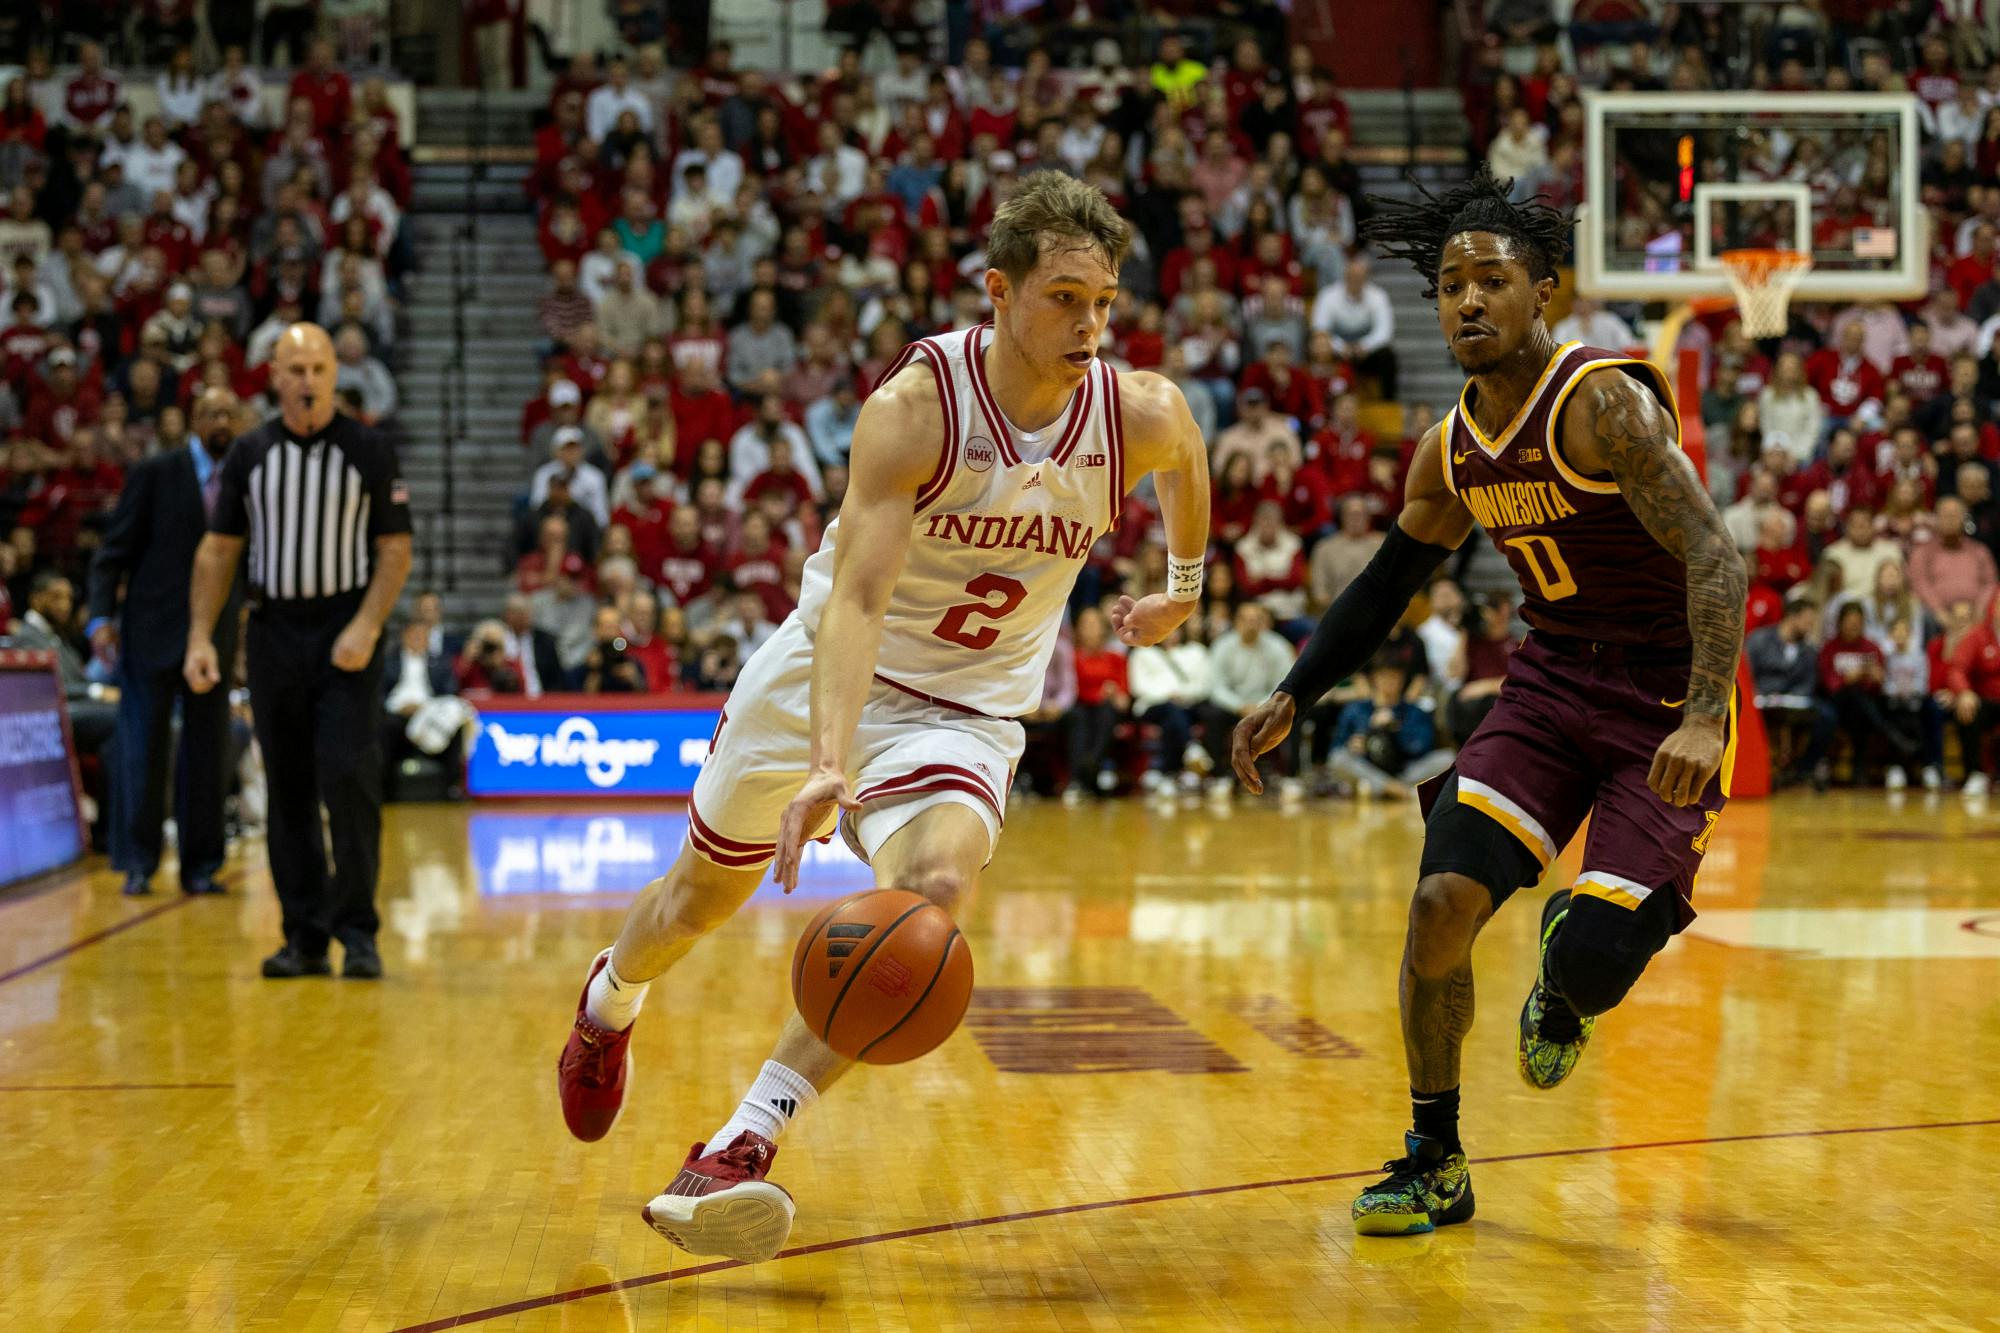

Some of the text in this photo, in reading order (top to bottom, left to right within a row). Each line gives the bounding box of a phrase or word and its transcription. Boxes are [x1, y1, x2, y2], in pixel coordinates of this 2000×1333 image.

[966, 448, 993, 463] RMK
[1460, 481, 1579, 528] MINNESOTA
[923, 514, 1094, 560] INDIANA
[1504, 535, 1578, 602] 0
[931, 572, 1029, 650] 2
